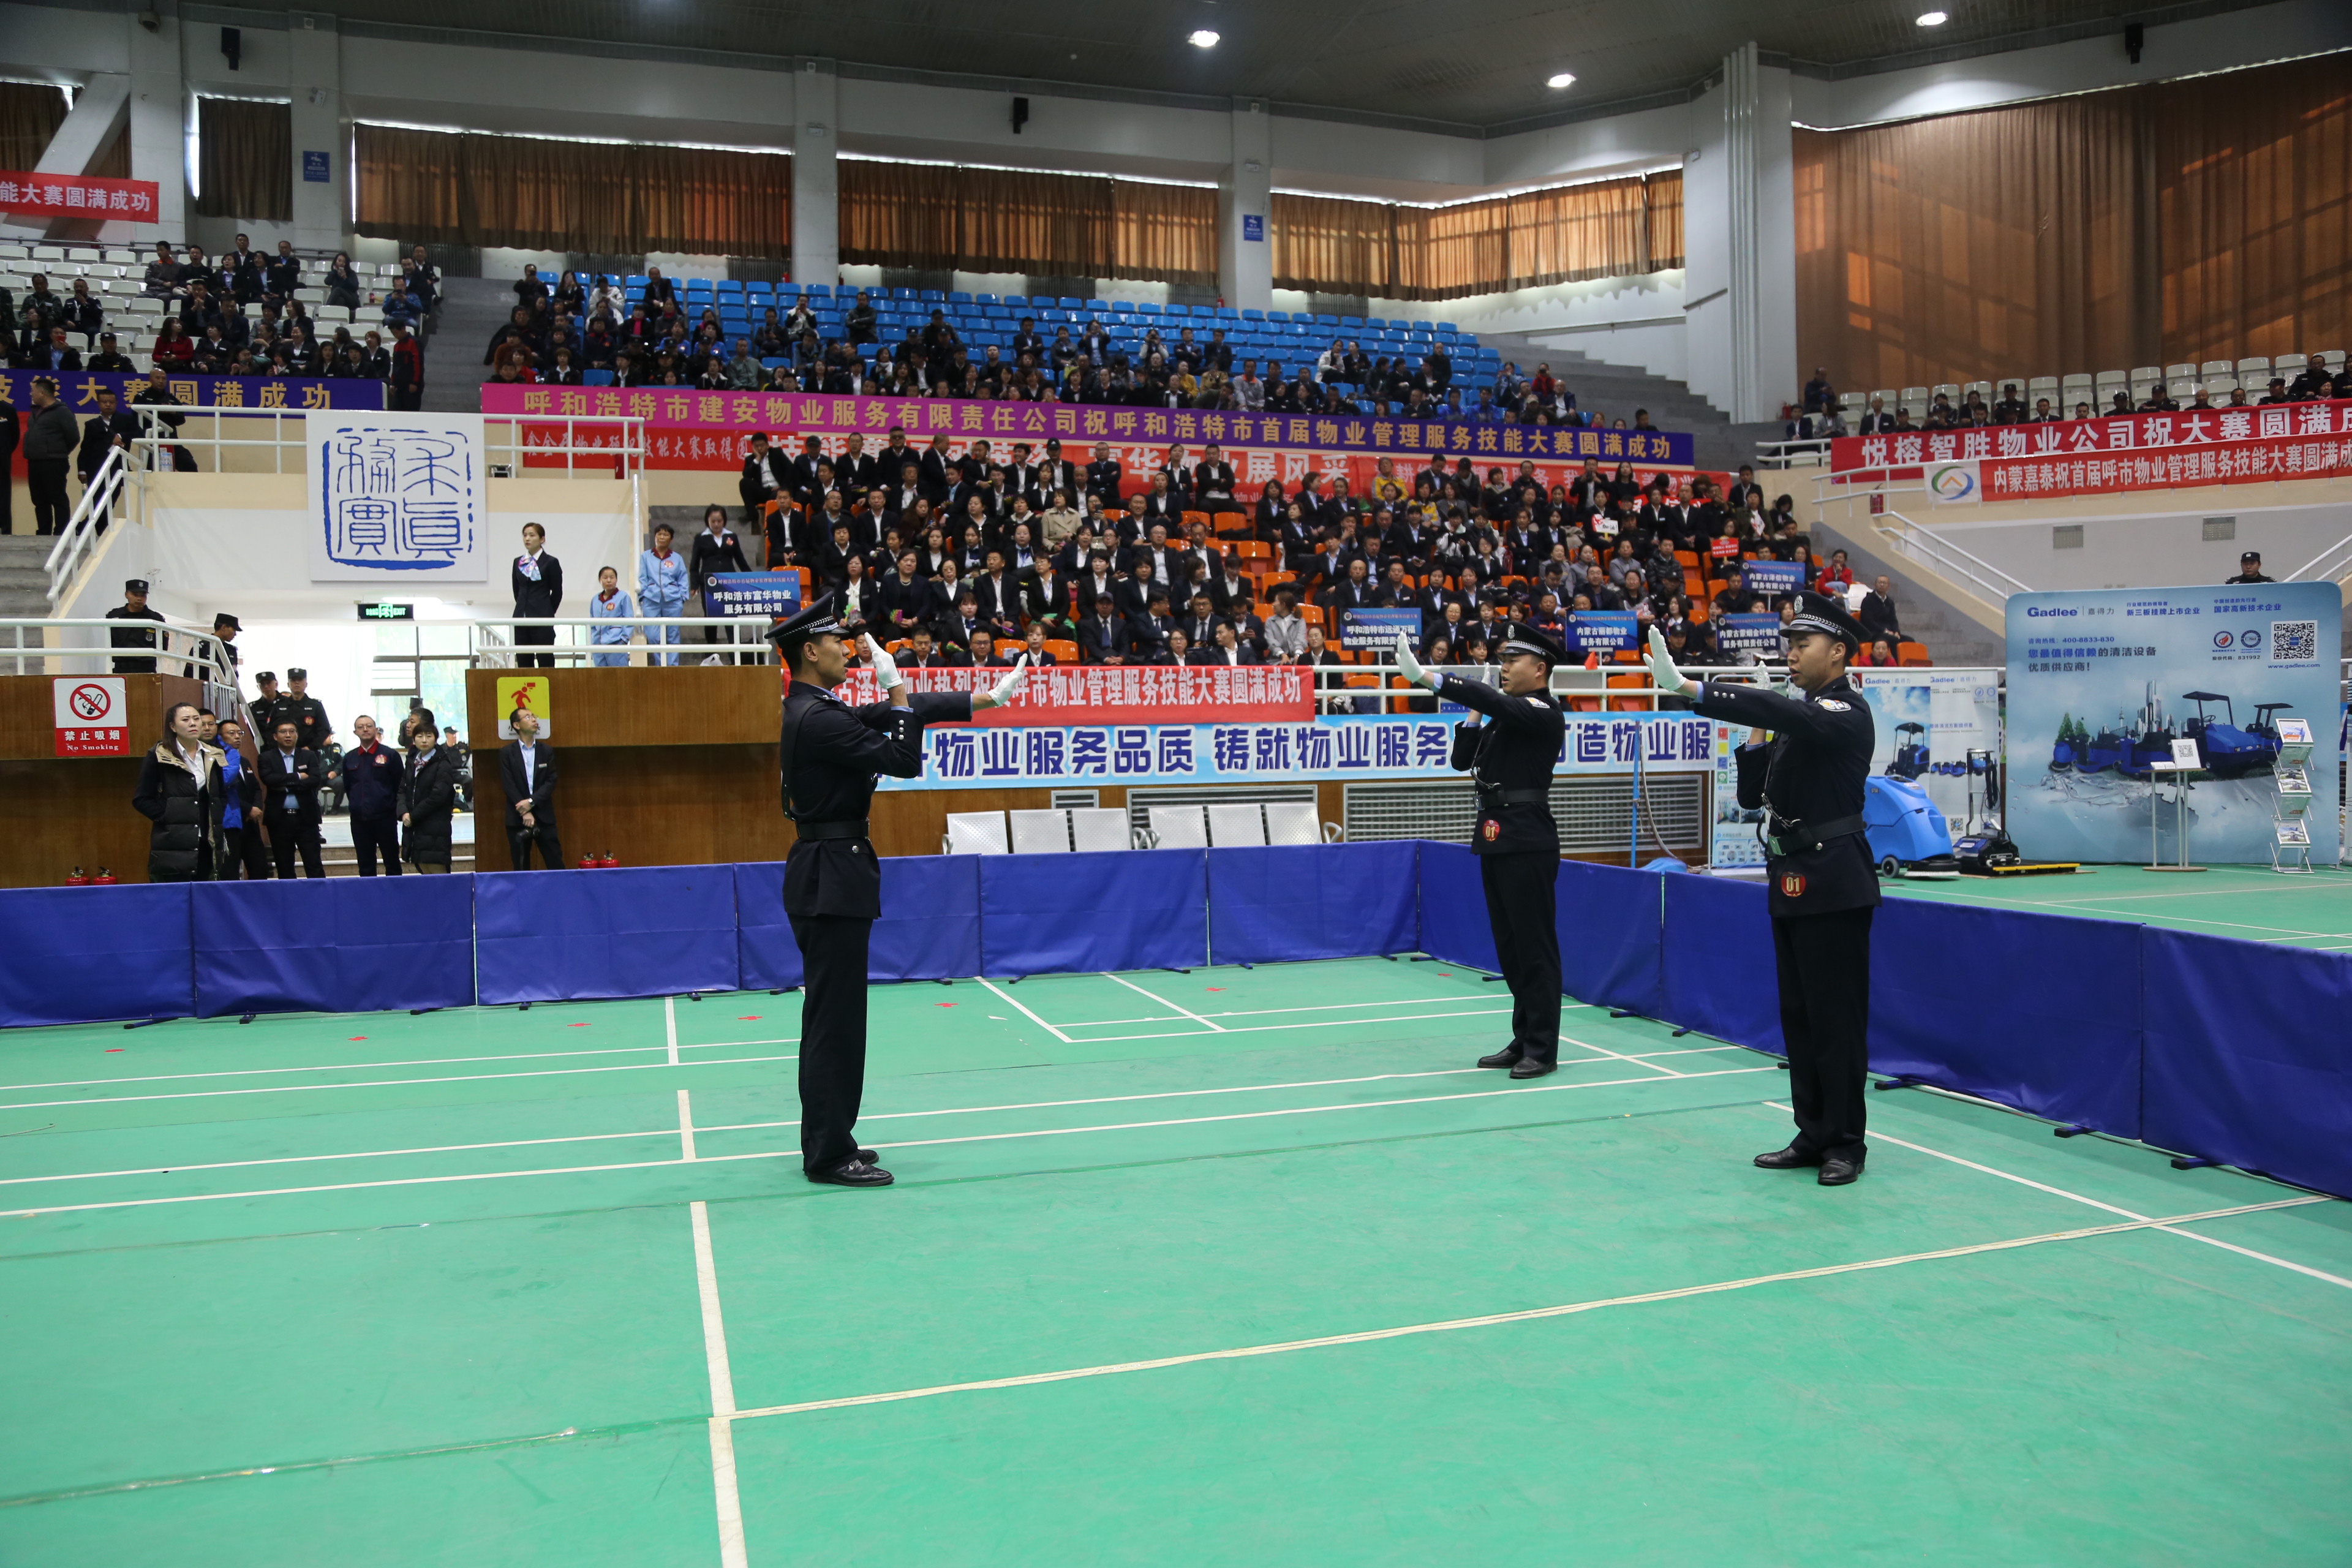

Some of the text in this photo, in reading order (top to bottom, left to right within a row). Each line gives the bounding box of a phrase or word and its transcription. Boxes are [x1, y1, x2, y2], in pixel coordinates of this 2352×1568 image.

[1752, 581, 1792, 590] 服务有限公司
[713, 589, 791, 601] 呼和浩市富华物业
[724, 602, 782, 614] 服务有限公司
[2027, 606, 2078, 617] Gadlee
[2127, 606, 2200, 617] 新三板挂牌上市企业
[2214, 603, 2282, 614] 国家高新技术企业
[1343, 636, 1420, 646] 物业服务有限责公司
[1580, 637, 1624, 646] 服务有限公司
[1722, 638, 1776, 649] 服务有限责任公司
[2028, 646, 2157, 658] 您最值得信赖的清洁设备
[64, 729, 120, 741] 禁止吸烟
[1485, 826, 1496, 839] 01
[1786, 876, 1800, 892] 01
